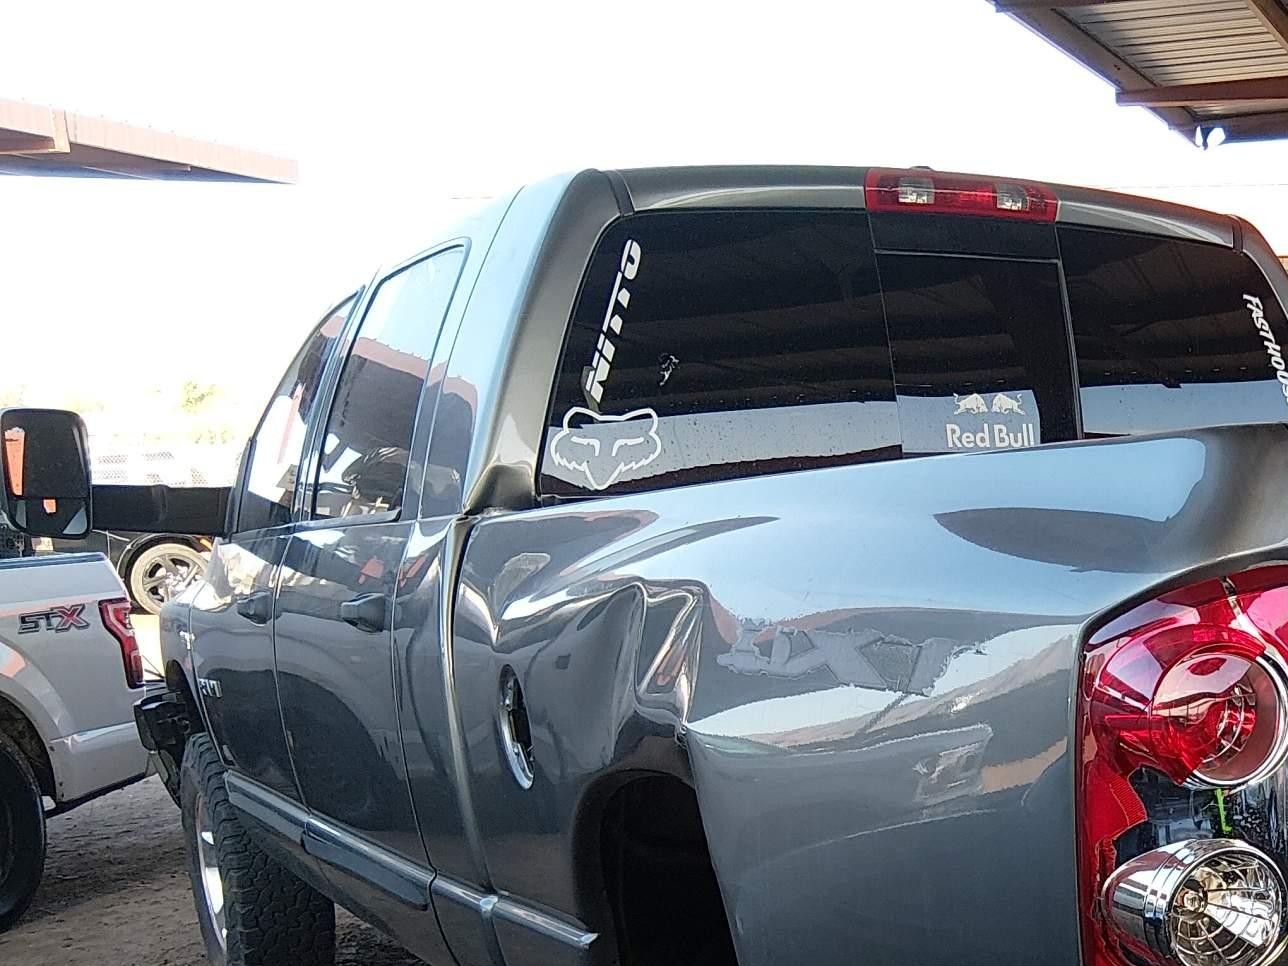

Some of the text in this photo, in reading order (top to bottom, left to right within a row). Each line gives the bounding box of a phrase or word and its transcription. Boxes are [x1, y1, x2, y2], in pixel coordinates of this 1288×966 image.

[584, 239, 642, 404] NITTO
[946, 423, 1035, 449] Red Bull
[18, 603, 90, 635] STX
